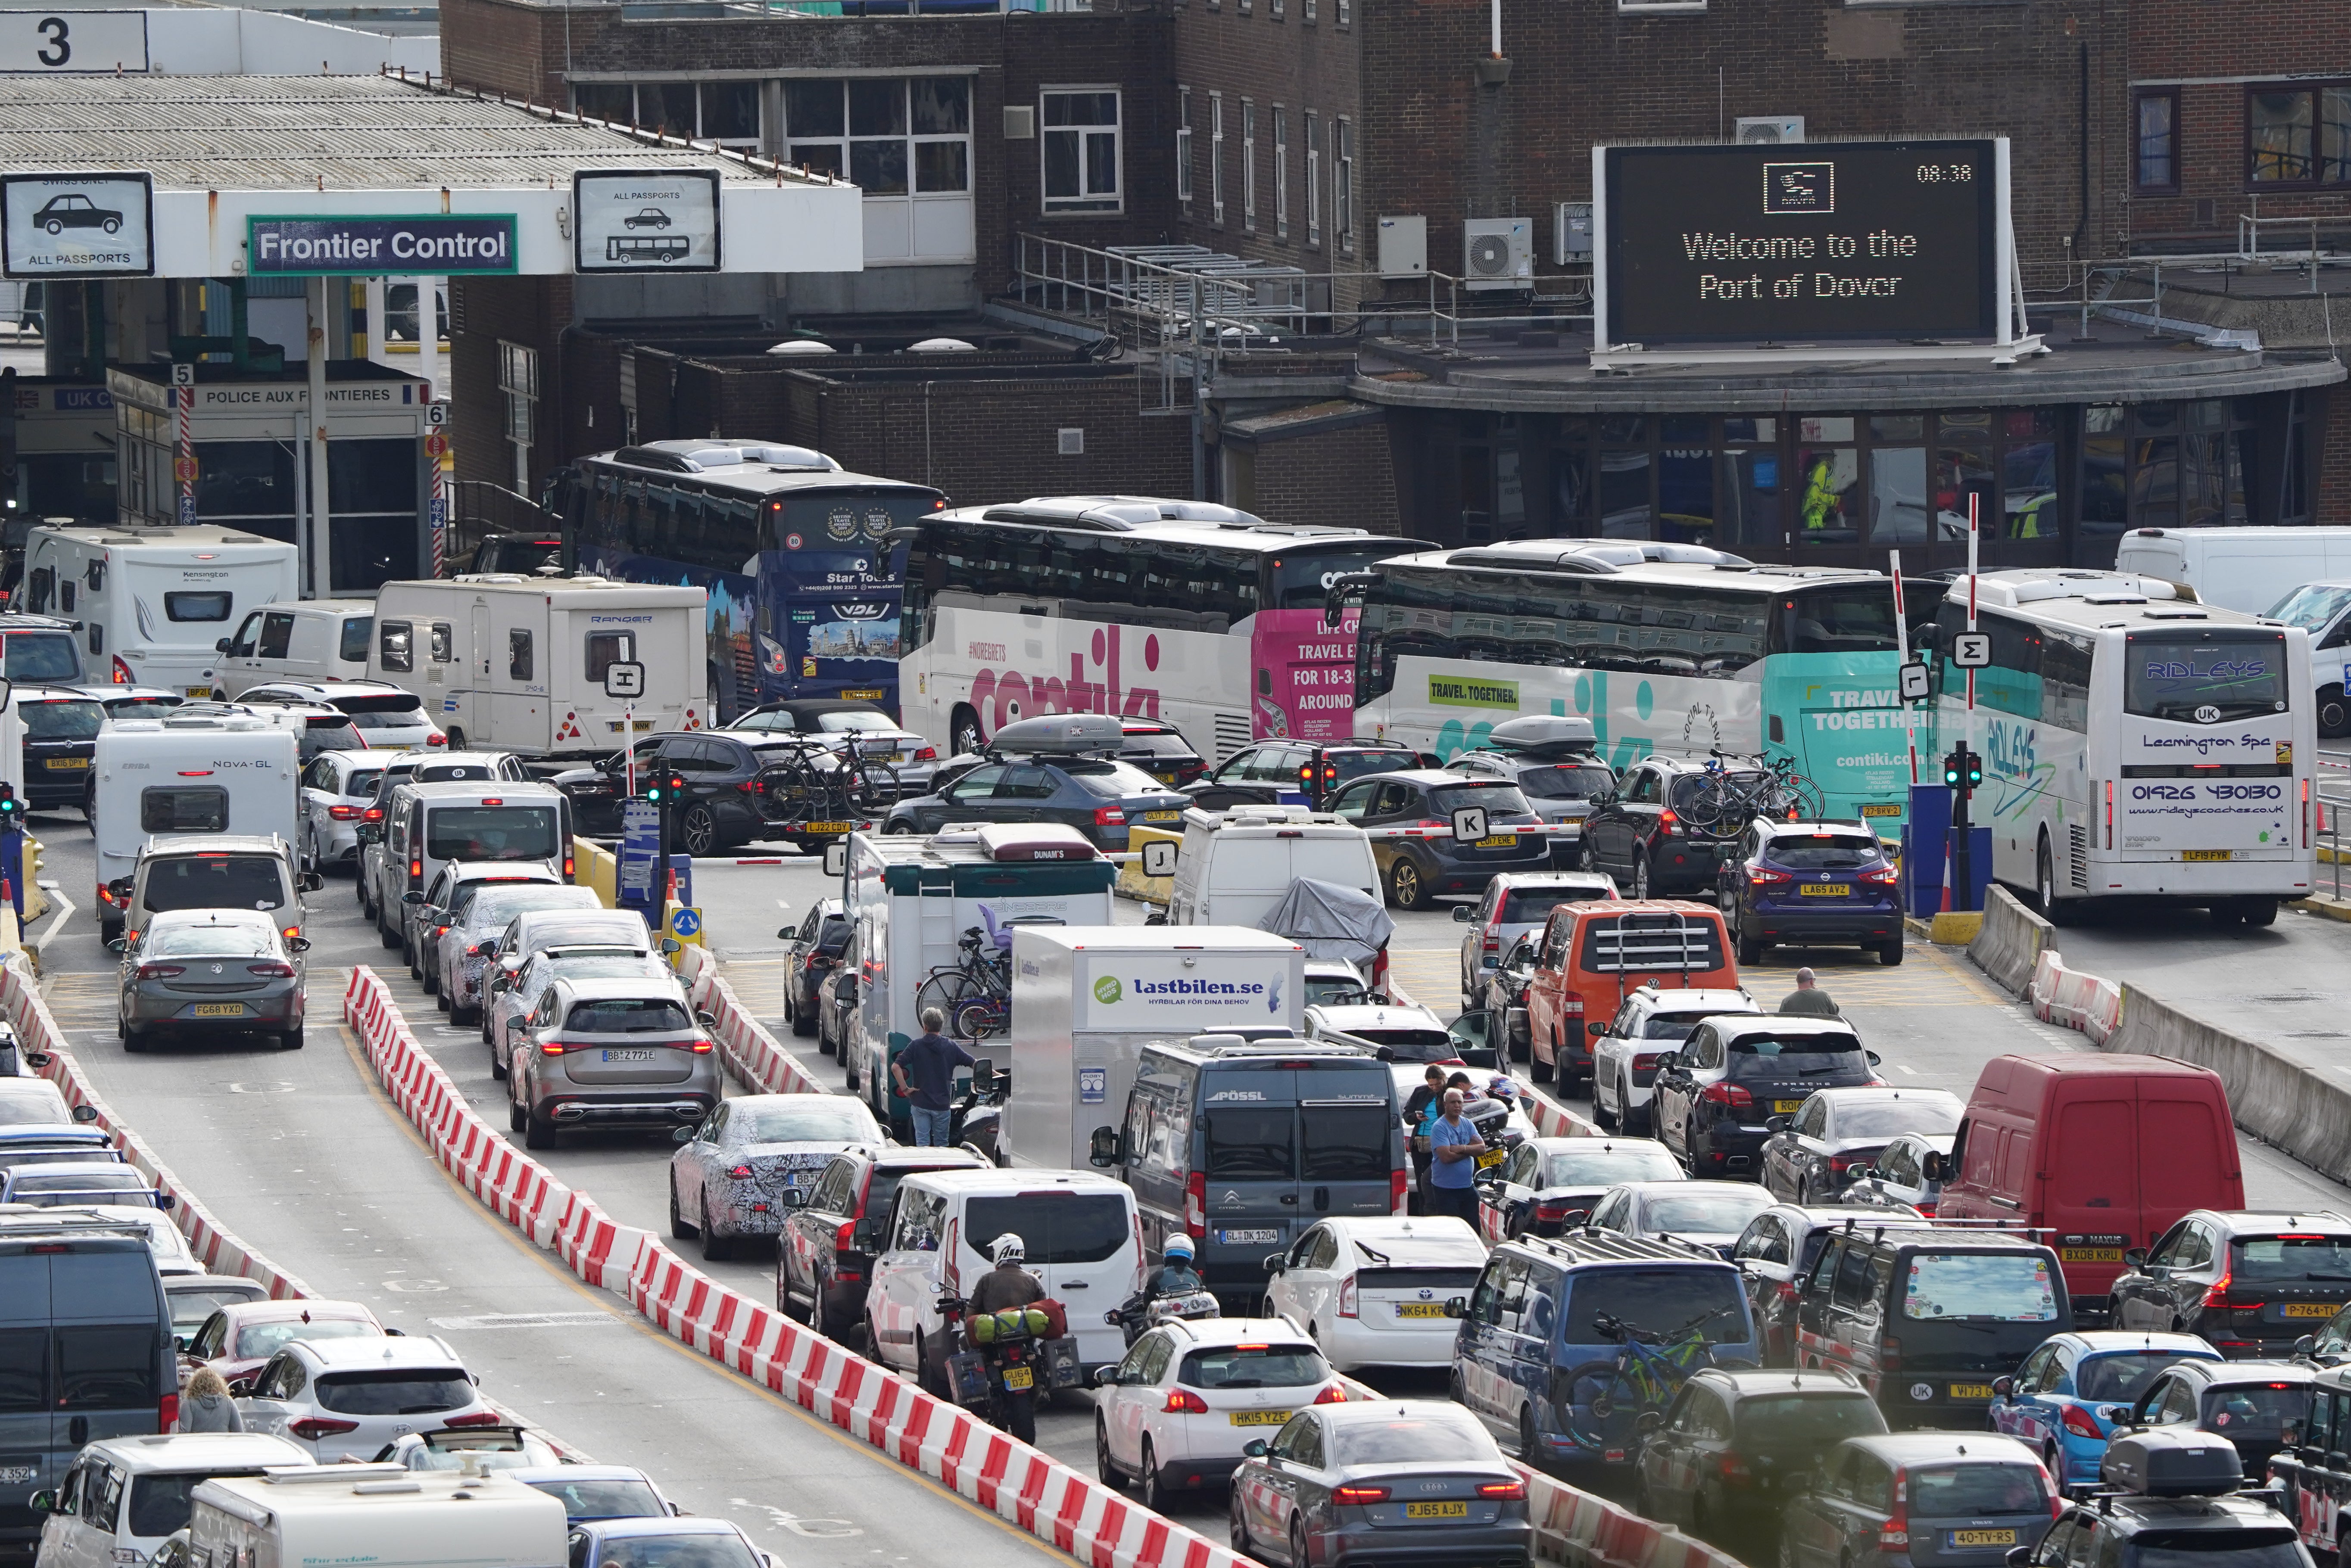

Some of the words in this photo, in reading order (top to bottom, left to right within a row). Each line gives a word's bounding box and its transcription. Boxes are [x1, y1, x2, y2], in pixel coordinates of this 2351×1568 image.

[37, 17, 70, 67] 3
[1917, 165, 1971, 183] 08:38
[261, 232, 383, 259] Frontier
[392, 231, 506, 258] Control
[1682, 232, 1815, 260] Welcome
[1827, 233, 1855, 258] to
[1868, 230, 1917, 257] the
[29, 255, 53, 265] ALL
[56, 254, 130, 264] PASSPORTS
[1701, 274, 1762, 300] Port
[1774, 273, 1803, 299] of
[177, 365, 189, 383] 5
[68, 392, 92, 406] UK
[207, 392, 261, 404] POLICE
[266, 391, 293, 403] AUX
[299, 389, 390, 402] FNTIERES
[430, 406, 442, 422] 6
[827, 573, 854, 583] Star
[841, 604, 878, 615] VDL
[1317, 620, 1340, 635] LIFE
[969, 641, 1006, 662] #NOREGRETS
[1298, 644, 1342, 659] TRAVEL
[1964, 641, 1981, 658] M
[2147, 660, 2265, 679] RIDLEYS
[617, 672, 633, 687] H
[1294, 670, 1319, 685] FOR
[1908, 677, 1921, 689] L
[1431, 682, 1467, 699] TRAVEL.
[1469, 685, 1516, 703] TOGETHER.
[1830, 690, 1927, 708] TRAVE
[1299, 694, 1353, 709] AROUND
[2198, 708, 2217, 719] UK
[1683, 701, 1702, 743] SOCIAL
[1988, 716, 2035, 780] RIDLEYS
[2143, 734, 2235, 754] Leamington
[2241, 734, 2271, 750] Spa
[213, 759, 272, 768] NOVA-GL
[1837, 753, 1925, 767] contiki.com
[2133, 785, 2196, 800] 01926
[2206, 785, 2281, 800] 430130
[1865, 806, 1898, 816] 27-BRV-2
[2129, 806, 2284, 818] www.ridleyscoaches.co.uk
[810, 822, 828, 832] LJ22
[829, 822, 847, 832] CDY
[1464, 816, 1478, 833] K
[1498, 836, 1512, 844] EHE
[1156, 851, 1164, 867] J
[2189, 851, 2209, 860] LF19
[2211, 851, 2228, 860] FYR
[1804, 885, 1827, 895] LA65
[1829, 885, 1846, 895] AVZ
[1097, 980, 1117, 995] HYRD
[1101, 987, 1118, 1000] HOS
[1135, 979, 1263, 995] lastbilen.se
[196, 1004, 219, 1015] FG68
[220, 1004, 241, 1015] YXD
[608, 1051, 620, 1061] BB
[624, 1051, 631, 1061] Z
[633, 1050, 655, 1061] 771E
[1219, 1089, 1267, 1101] PÖSSL
[1481, 1151, 1500, 1161] HN16
[797, 1174, 810, 1184] BB
[1227, 1229, 1237, 1240] GL
[1244, 1229, 1254, 1239] DK
[1257, 1229, 1277, 1239] 1204
[2089, 1235, 2122, 1244] MAXUS
[2067, 1250, 2094, 1260] BX08
[2097, 1250, 2117, 1260] KRU
[1400, 1305, 1428, 1317] NK64
[1012, 1378, 1032, 1388] DZJ
[1914, 1386, 1929, 1397] UK
[1237, 1412, 1262, 1422] HK15
[1265, 1411, 1286, 1422] YZE
[8, 1468, 28, 1478] 352
[1409, 1503, 1439, 1515] RJ65
[1442, 1503, 1464, 1514] AJX
[1958, 1531, 2012, 1543] 40-TV-RS
